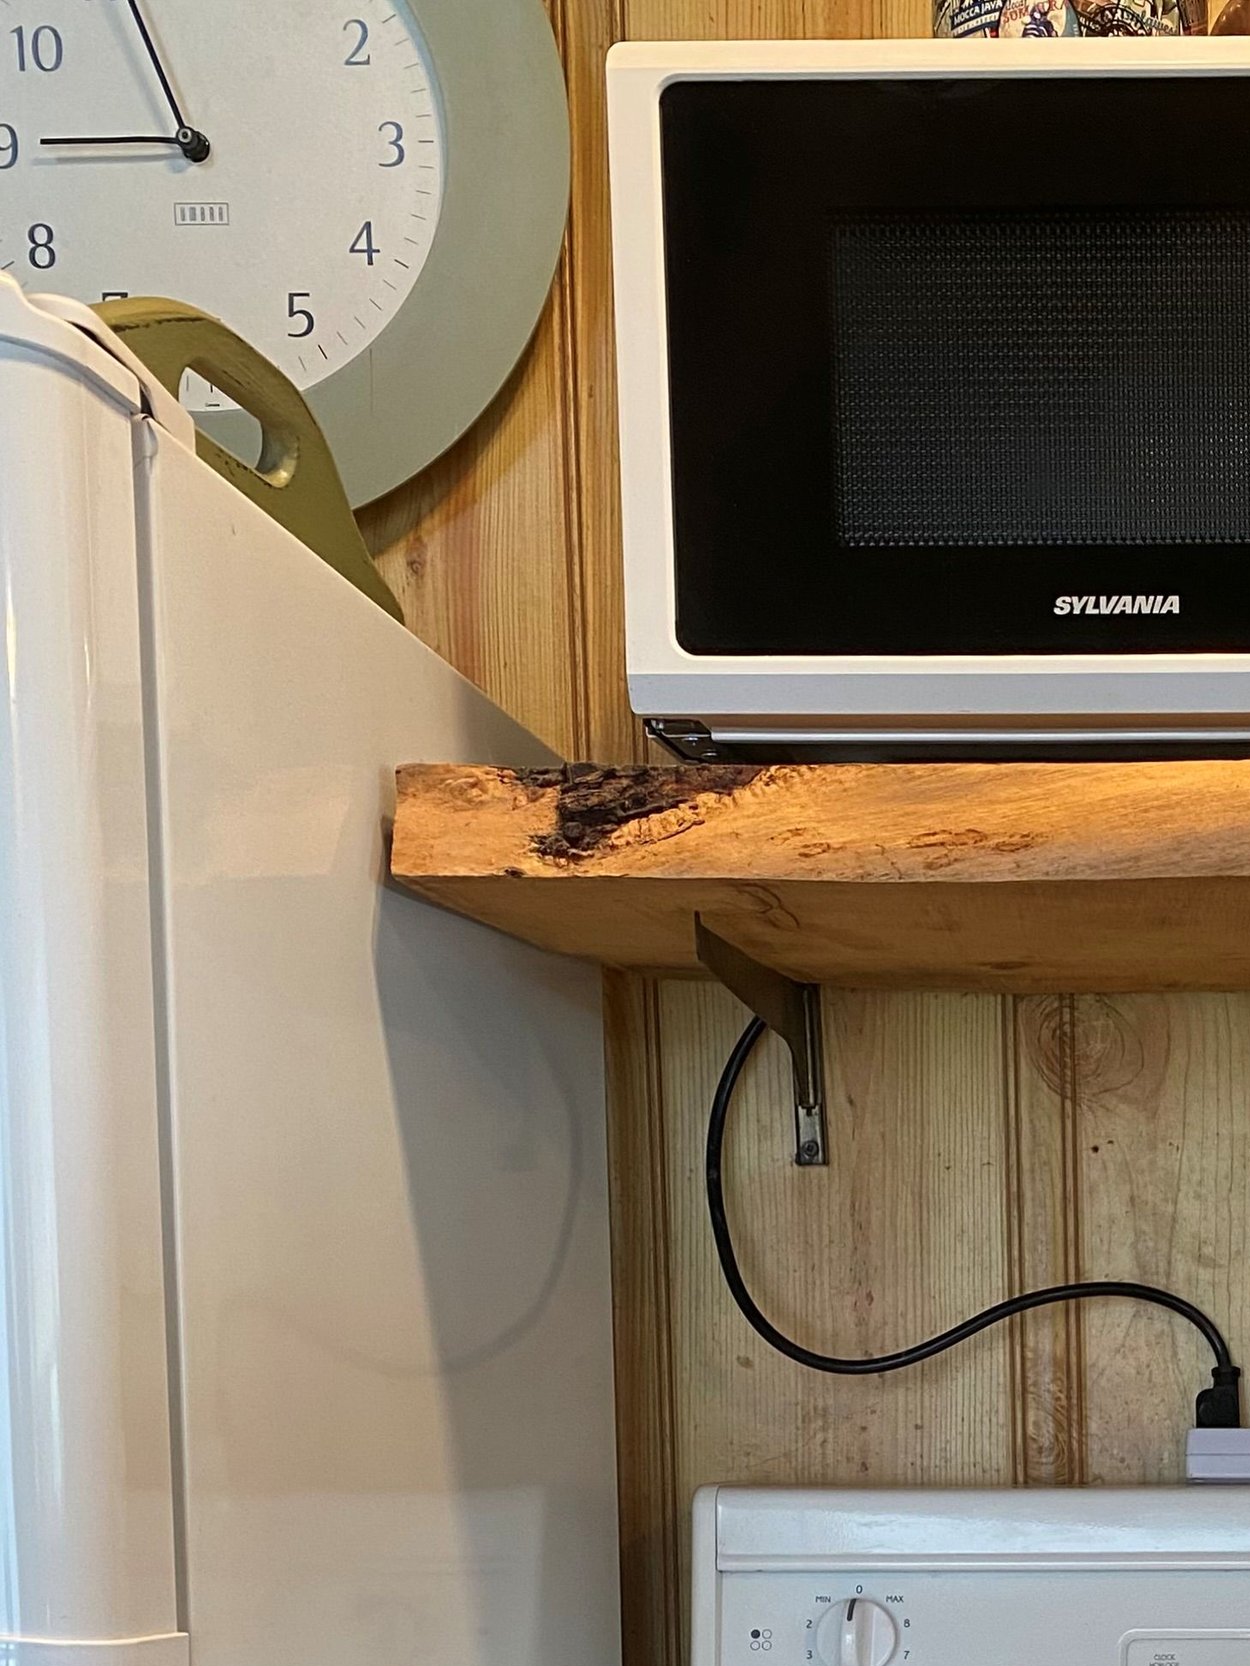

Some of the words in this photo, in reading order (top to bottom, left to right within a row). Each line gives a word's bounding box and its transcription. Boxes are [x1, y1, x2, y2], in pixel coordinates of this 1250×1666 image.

[954, 7, 980, 25] MOCCA
[981, 0, 1003, 14] JAVA
[10, 25, 63, 72] 10
[342, 19, 371, 66] 2
[0, 123, 18, 169] 9
[378, 121, 405, 167] 3
[28, 223, 56, 269] 8
[349, 221, 380, 266] 4
[287, 293, 314, 338] 5
[1053, 595, 1180, 615] SYLVANIA
[886, 1595, 904, 1603] MAX
[1153, 1653, 1176, 1661] CLOCK
